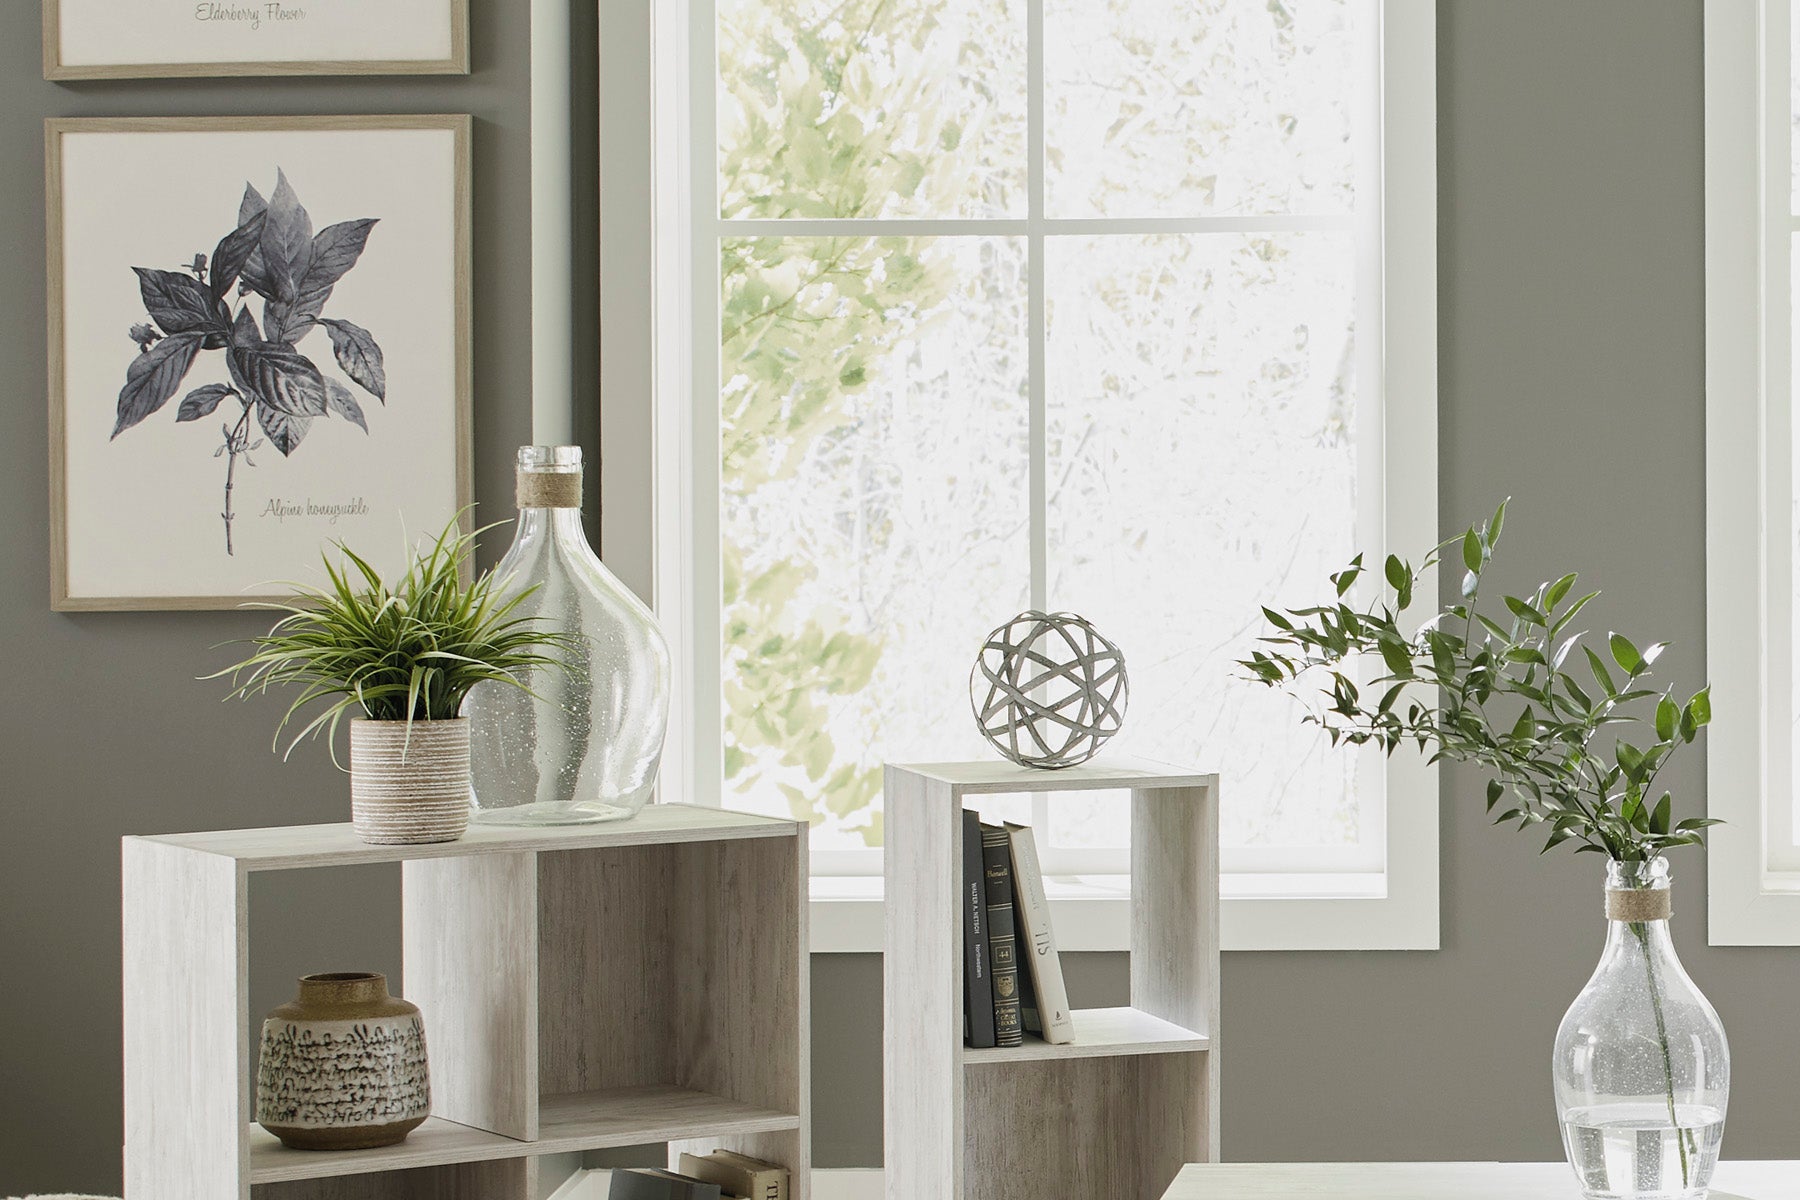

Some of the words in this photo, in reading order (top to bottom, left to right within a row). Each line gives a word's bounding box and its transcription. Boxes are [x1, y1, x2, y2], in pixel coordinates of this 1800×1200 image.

[194, 2, 261, 30] Elderberry
[264, 3, 307, 21] Flower
[259, 498, 305, 524] Alpine
[306, 497, 370, 525] honeysuckle
